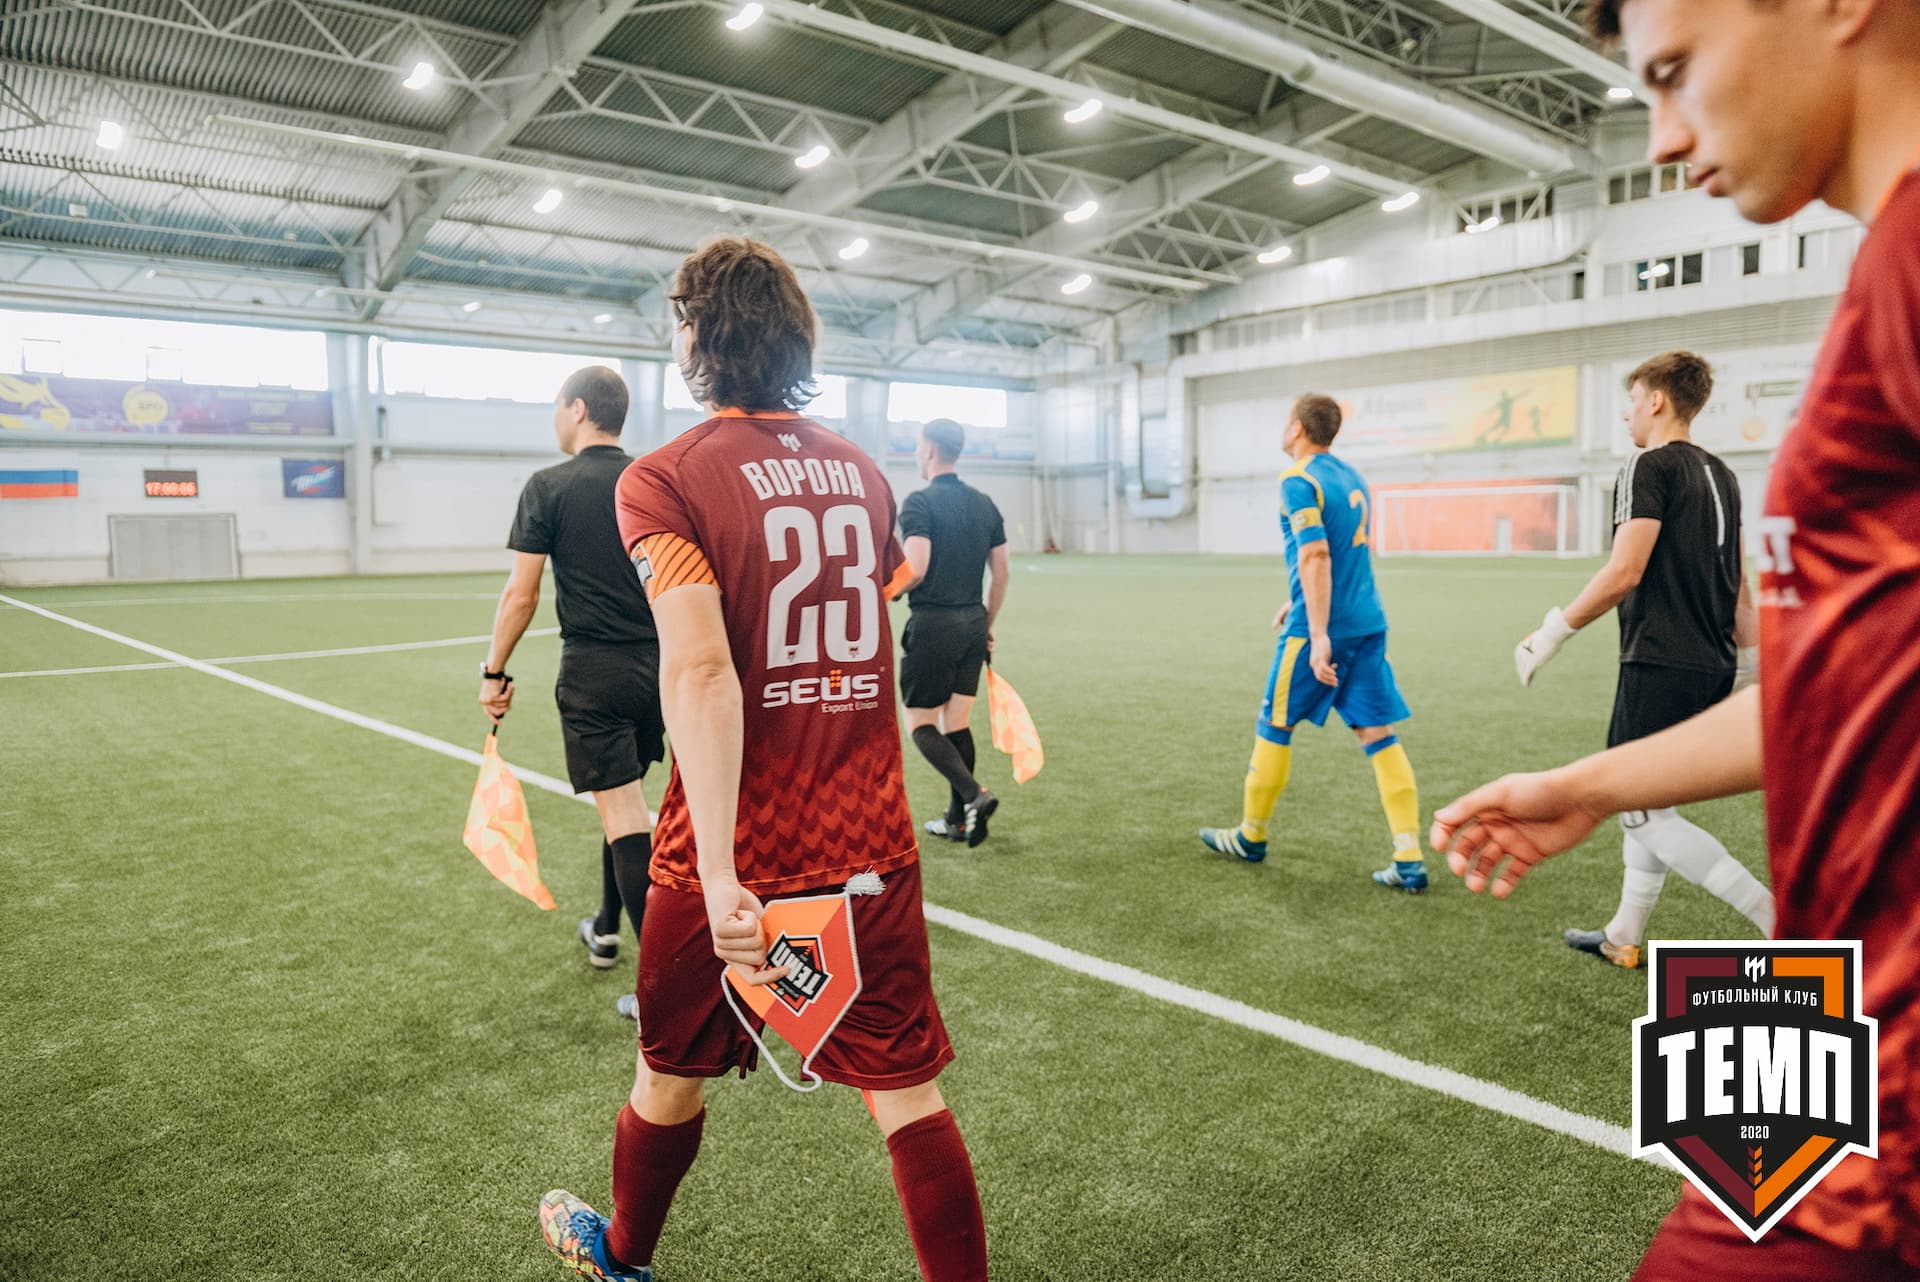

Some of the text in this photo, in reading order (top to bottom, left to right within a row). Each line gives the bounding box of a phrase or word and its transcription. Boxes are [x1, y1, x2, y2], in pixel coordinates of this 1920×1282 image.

[738, 458, 867, 501] ВОРОНА
[1348, 488, 1370, 548] 2
[763, 504, 880, 670] 23
[821, 701, 879, 714] Export Union
